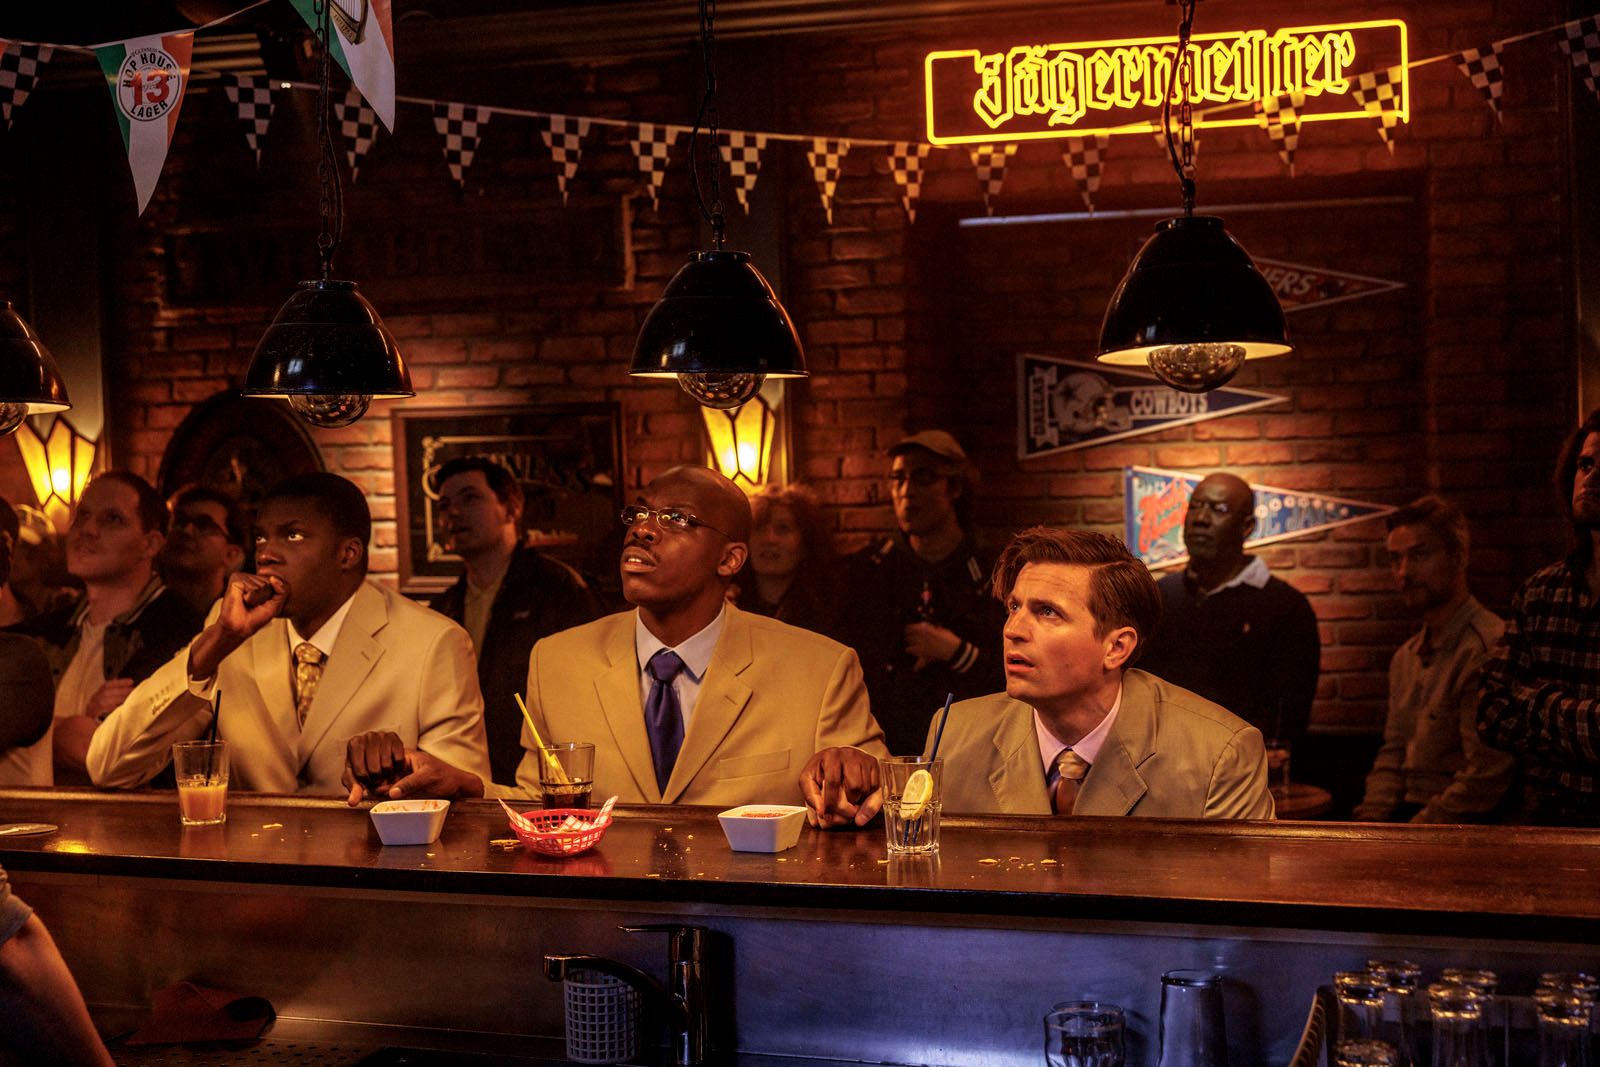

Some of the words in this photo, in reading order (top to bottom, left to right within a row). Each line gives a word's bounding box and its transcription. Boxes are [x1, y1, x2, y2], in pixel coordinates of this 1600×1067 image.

[122, 60, 138, 88] HOP
[131, 71, 170, 105] 13
[131, 99, 168, 118] LAGER
[1129, 388, 1209, 415] COWBOYS
